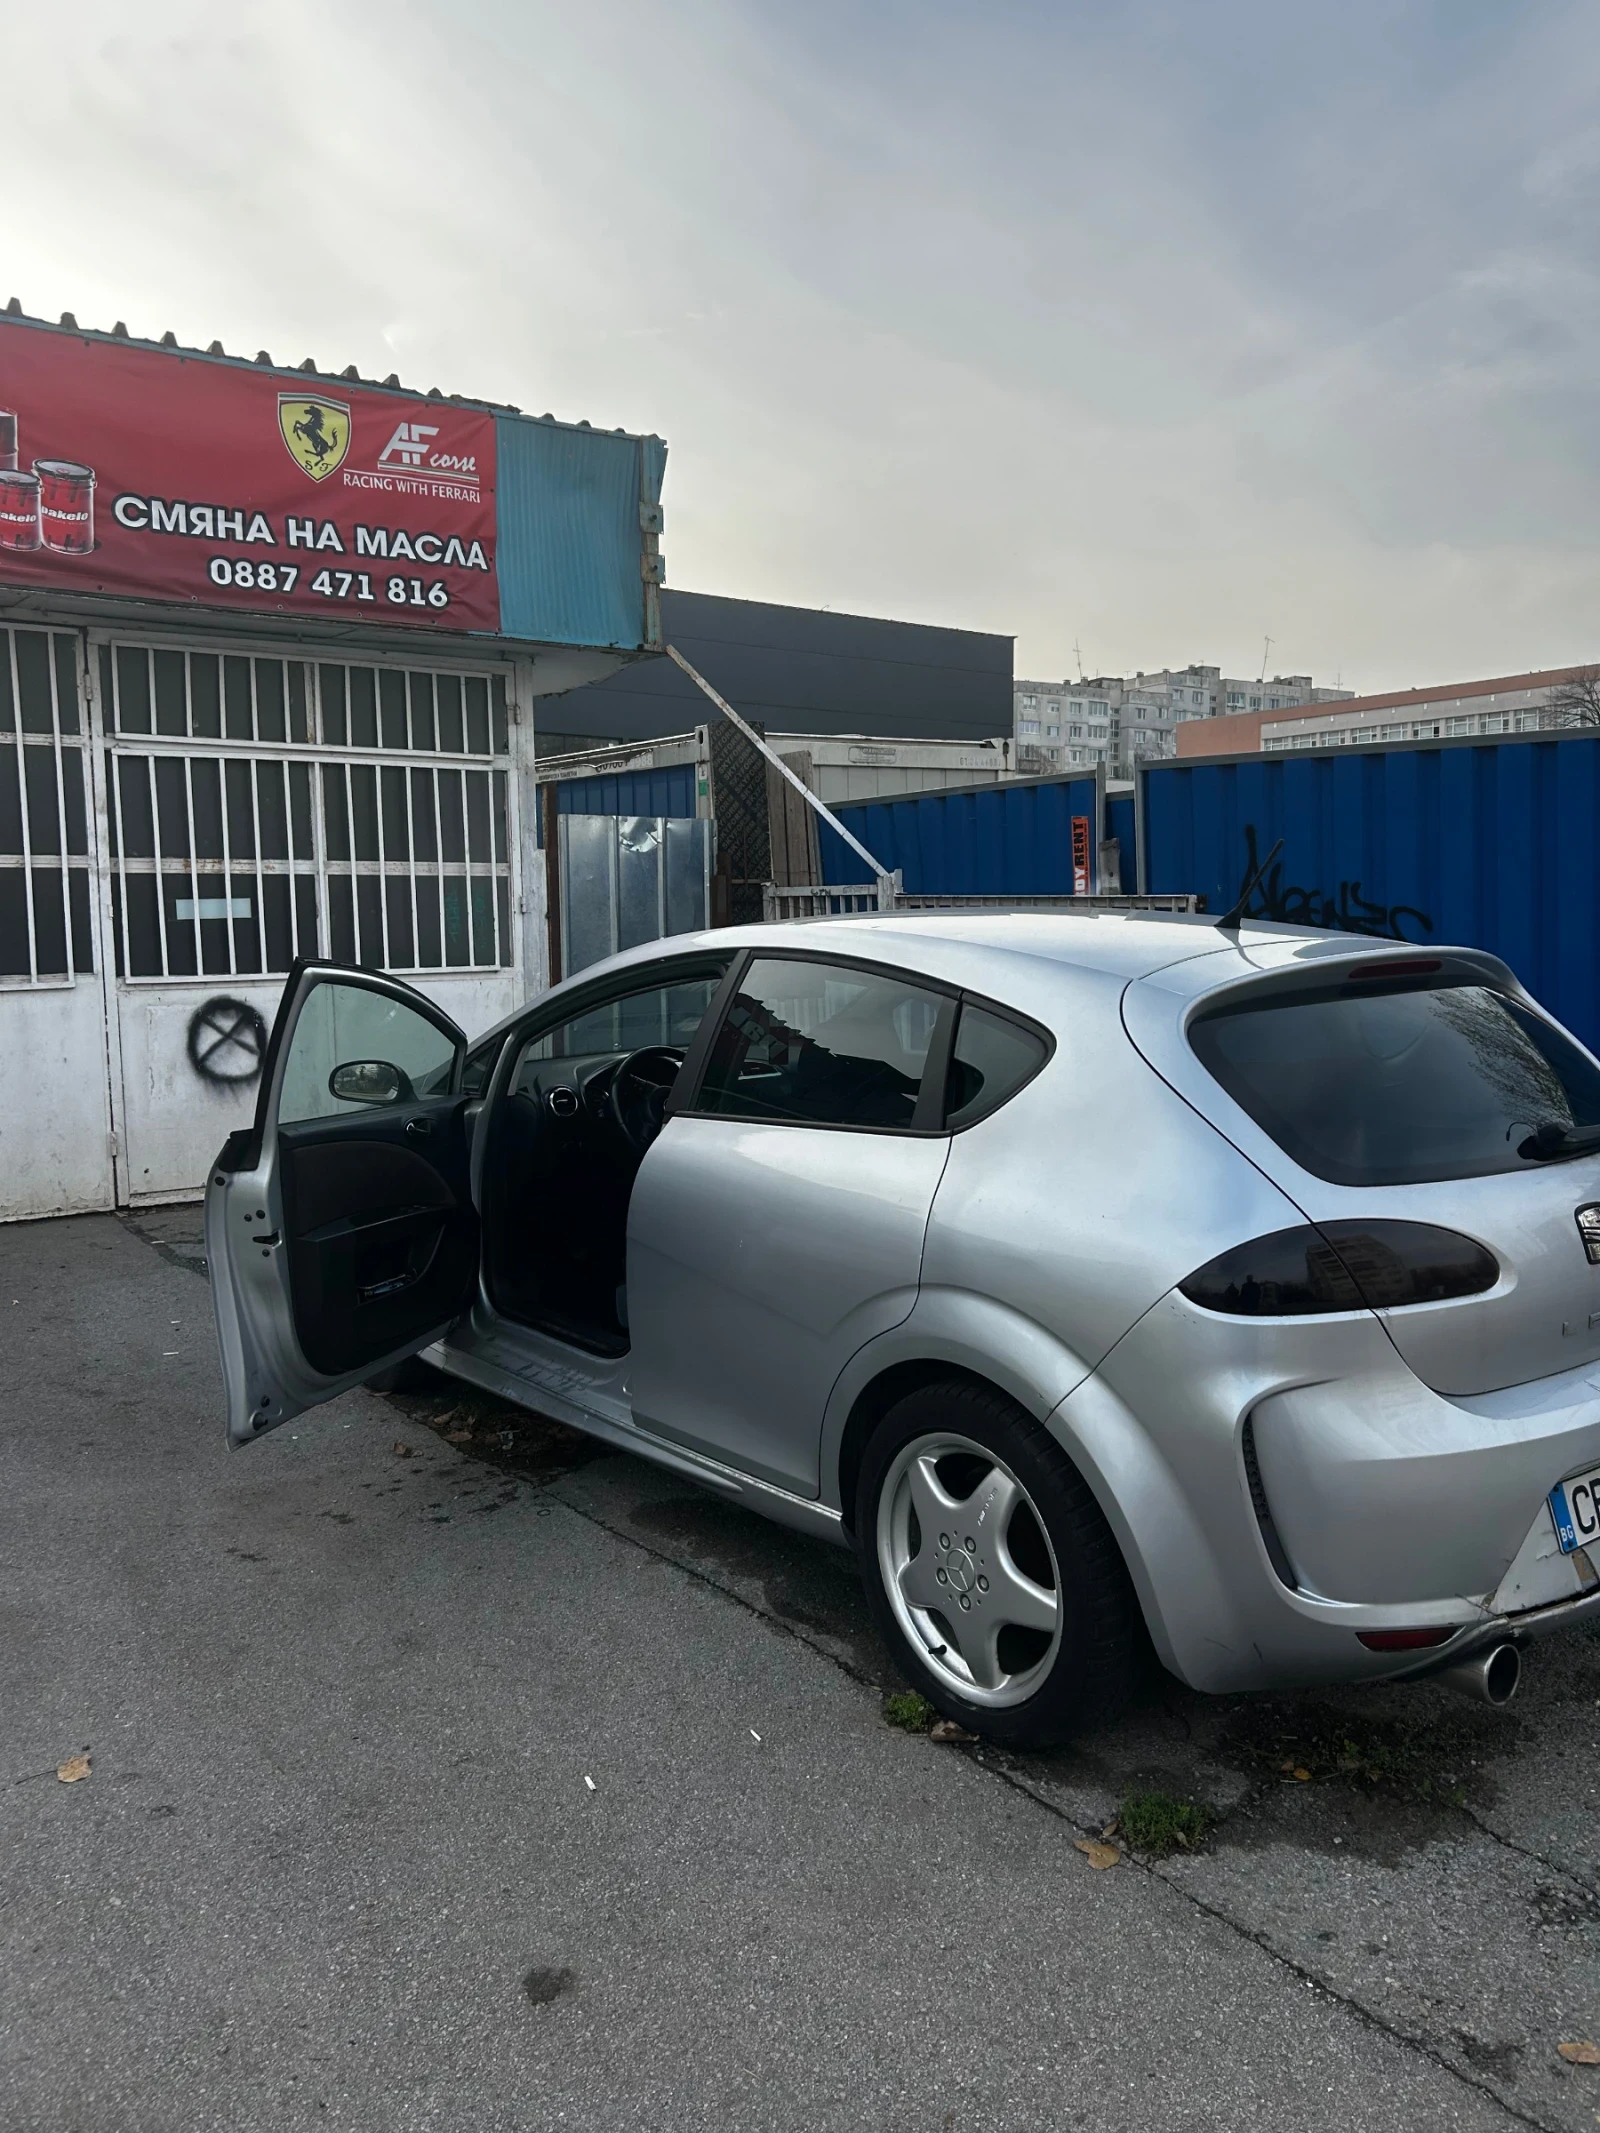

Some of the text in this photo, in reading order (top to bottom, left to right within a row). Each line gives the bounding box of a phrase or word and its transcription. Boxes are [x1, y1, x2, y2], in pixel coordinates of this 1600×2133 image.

[379, 422, 476, 471] AF corse
[343, 473, 481, 503] RACING WITH FERRARI
[114, 496, 488, 570] СМЯНА НА МАСЛА
[210, 558, 448, 608] 0887 471 816
[1560, 1525, 1574, 1542] BG
